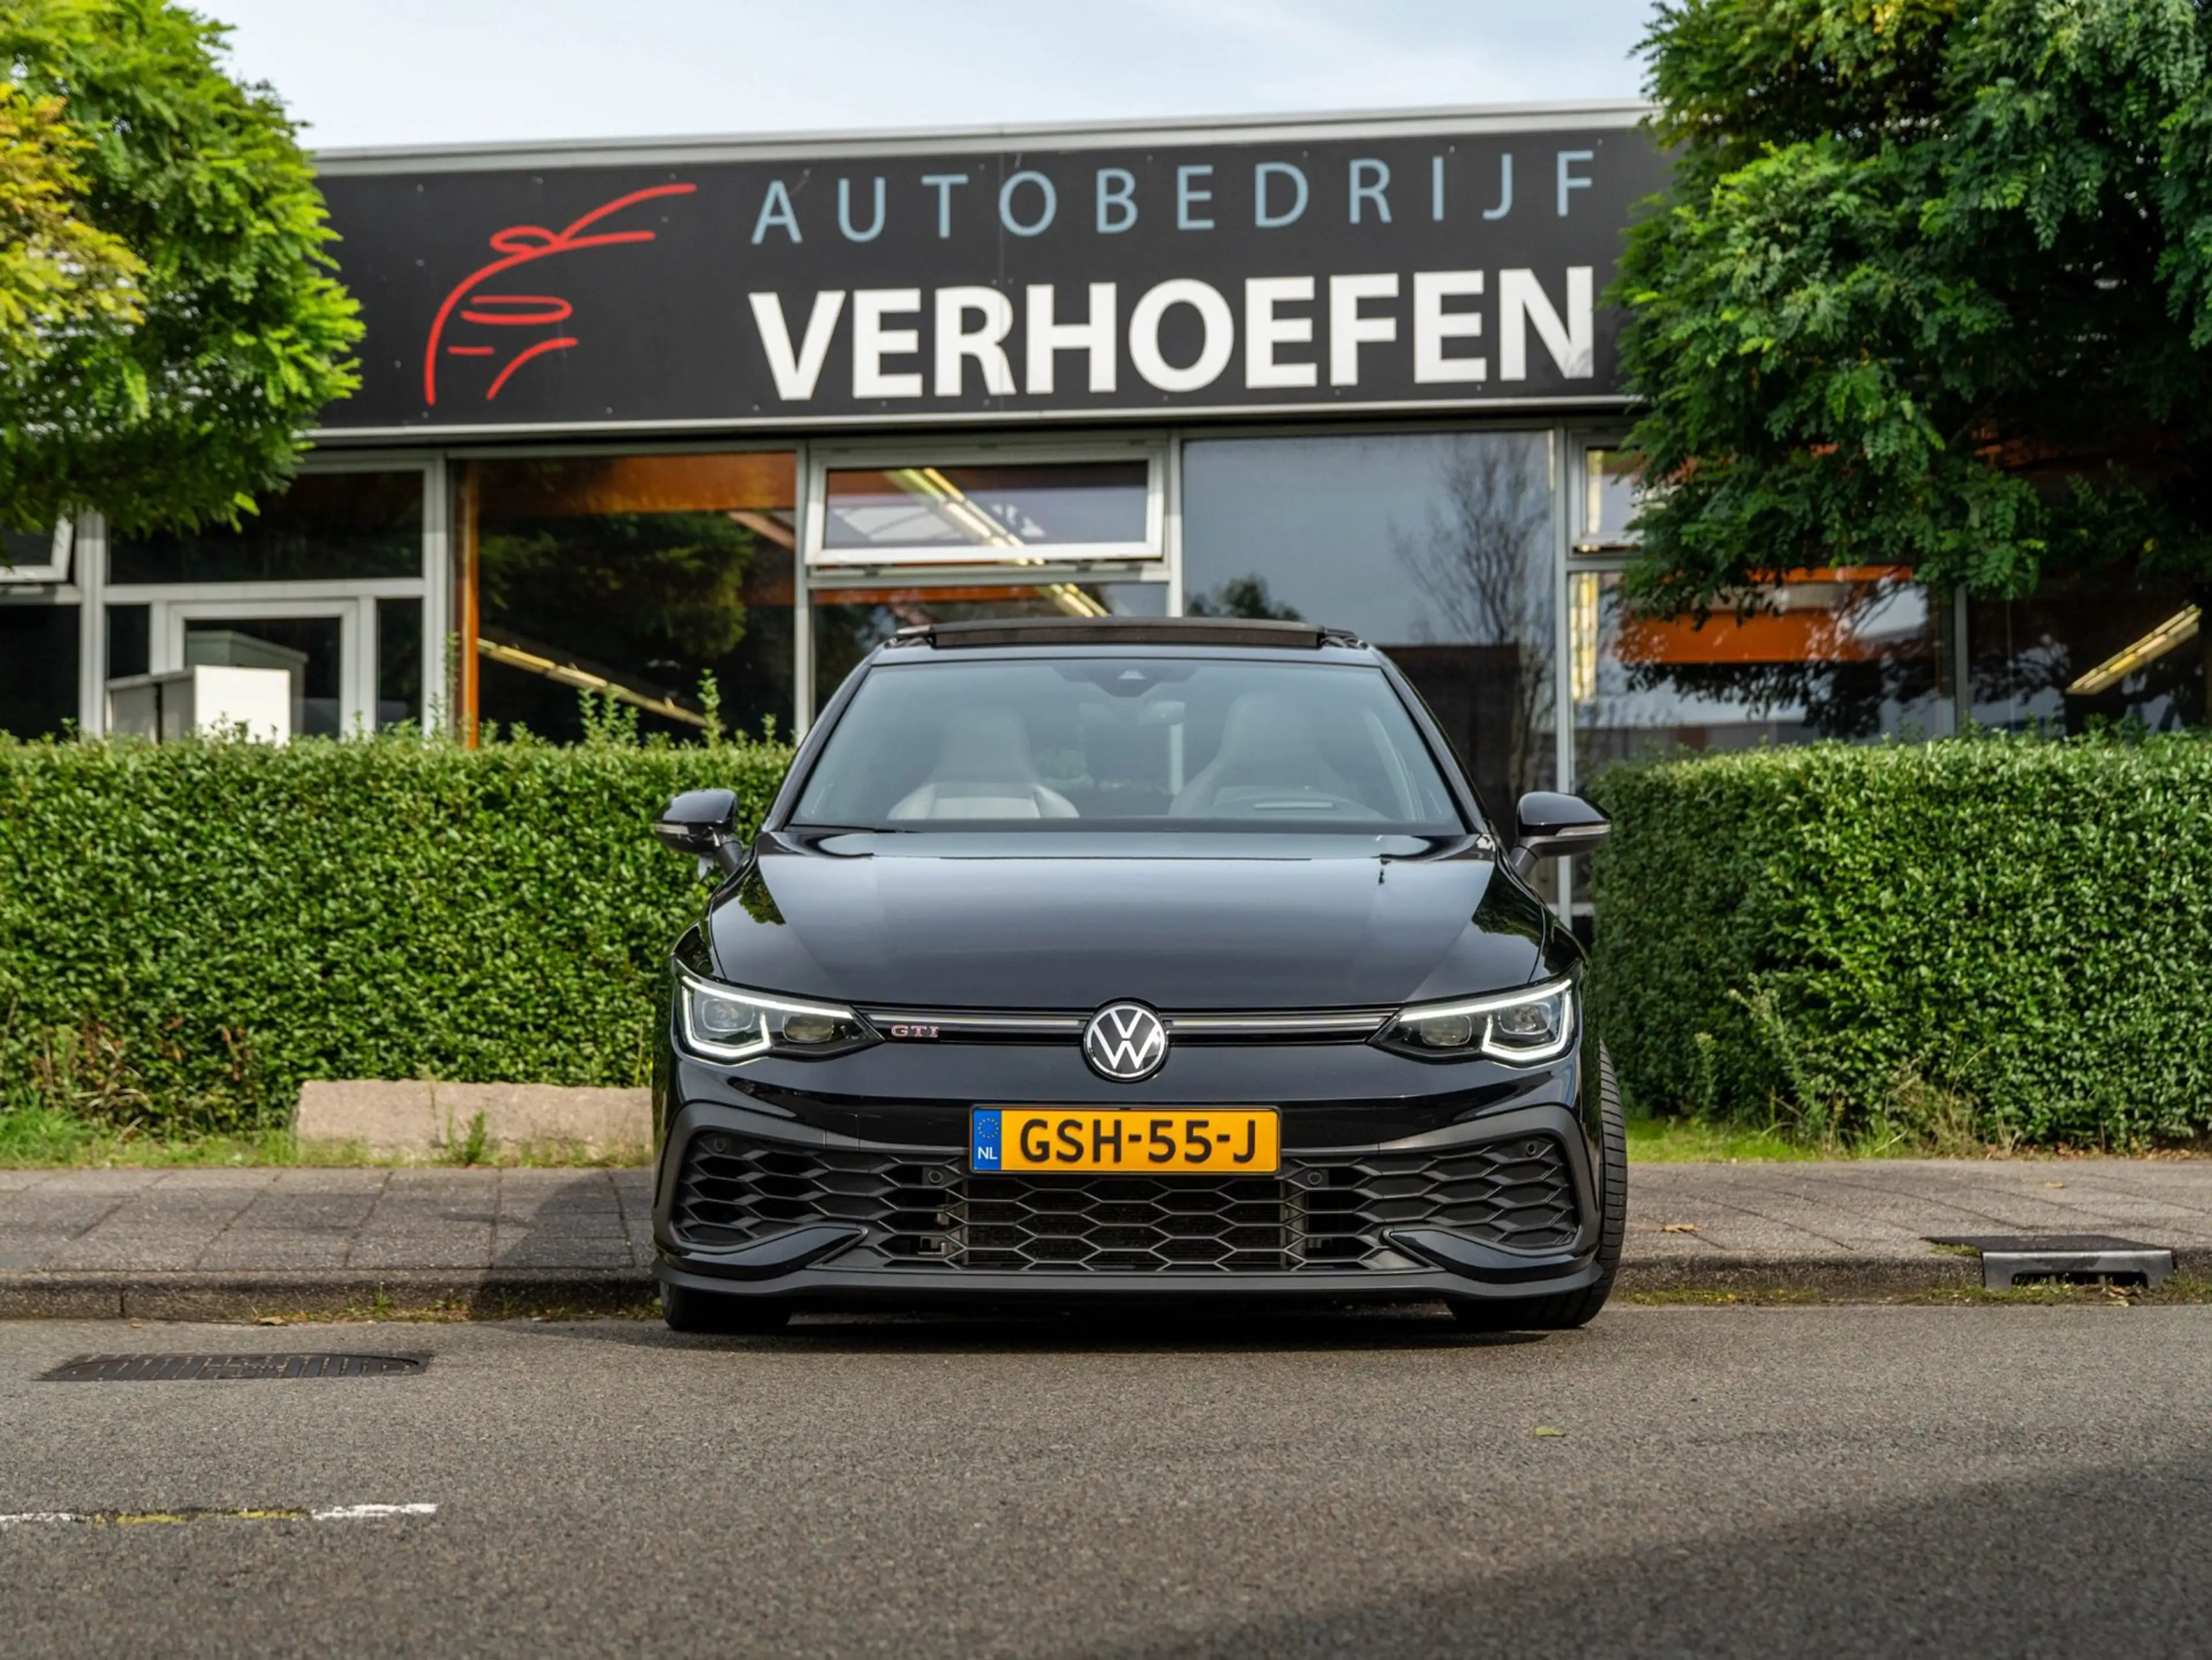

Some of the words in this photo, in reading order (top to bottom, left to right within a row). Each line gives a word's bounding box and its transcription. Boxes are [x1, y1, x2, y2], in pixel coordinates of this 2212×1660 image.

[751, 149, 1595, 244] AUTOBEDRIJF
[749, 266, 1595, 401] VERHOEFEN
[891, 1025, 939, 1038] GTI
[977, 1146, 998, 1160] NL
[1019, 1118, 1256, 1163] GSH-55-J
